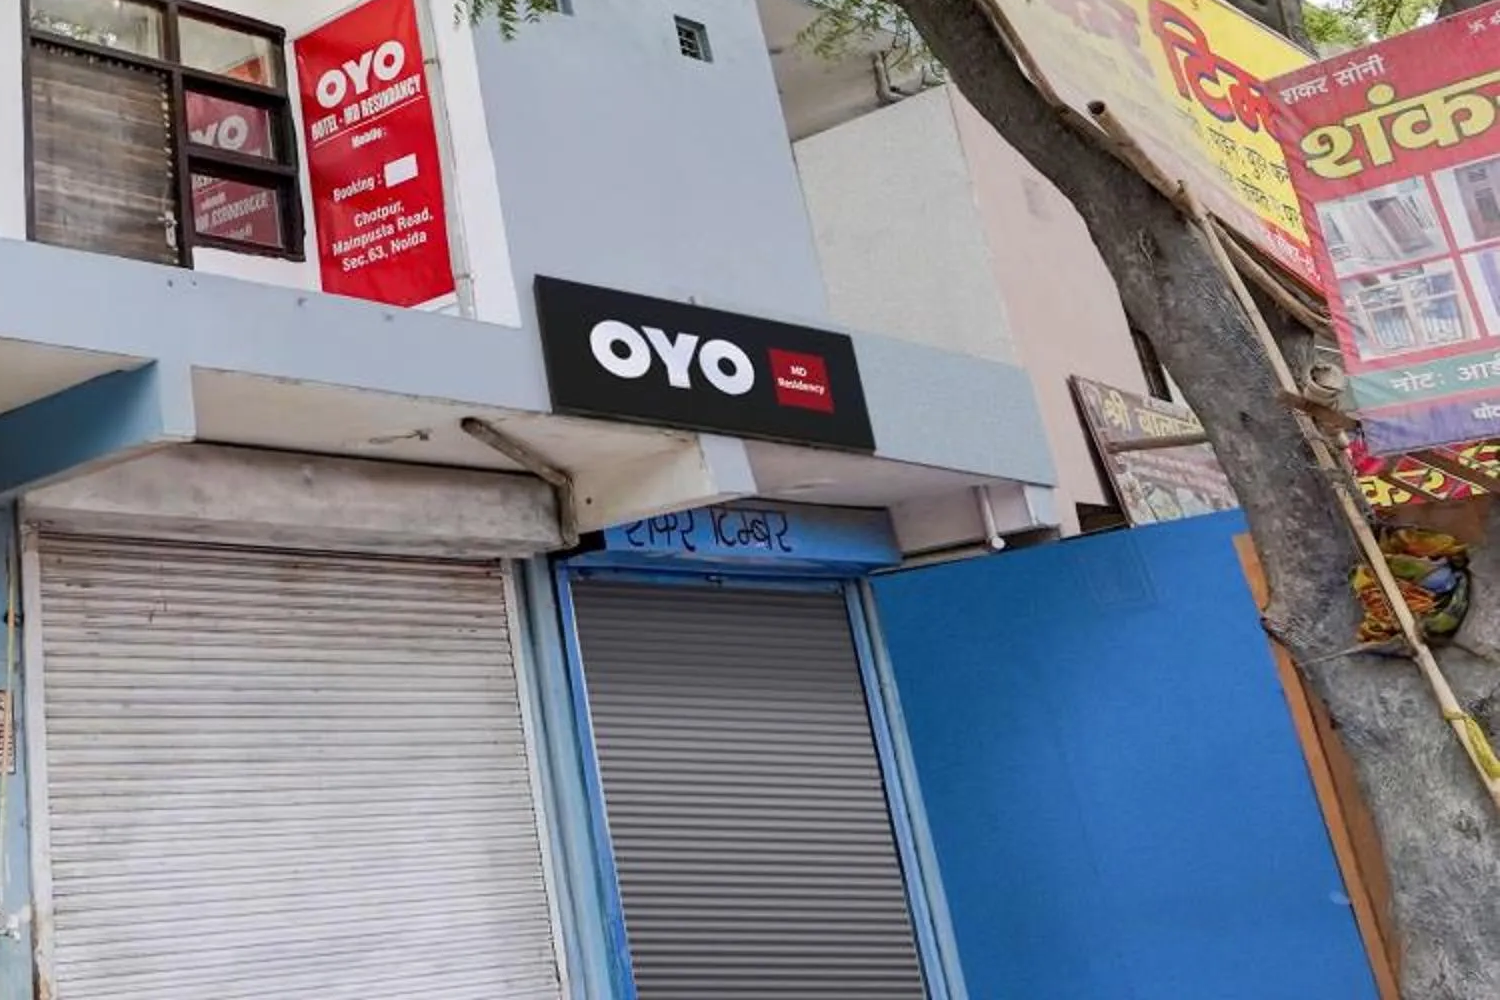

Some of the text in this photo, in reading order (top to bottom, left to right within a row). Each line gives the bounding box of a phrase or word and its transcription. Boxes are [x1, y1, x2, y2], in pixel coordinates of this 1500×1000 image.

[315, 39, 405, 109] OYO
[1332, 53, 1385, 87] सोनी
[1300, 69, 1500, 179] शंक
[390, 231, 428, 254] Noida
[589, 319, 755, 396] OYO
[790, 365, 807, 377] MD
[777, 377, 825, 396] Residency
